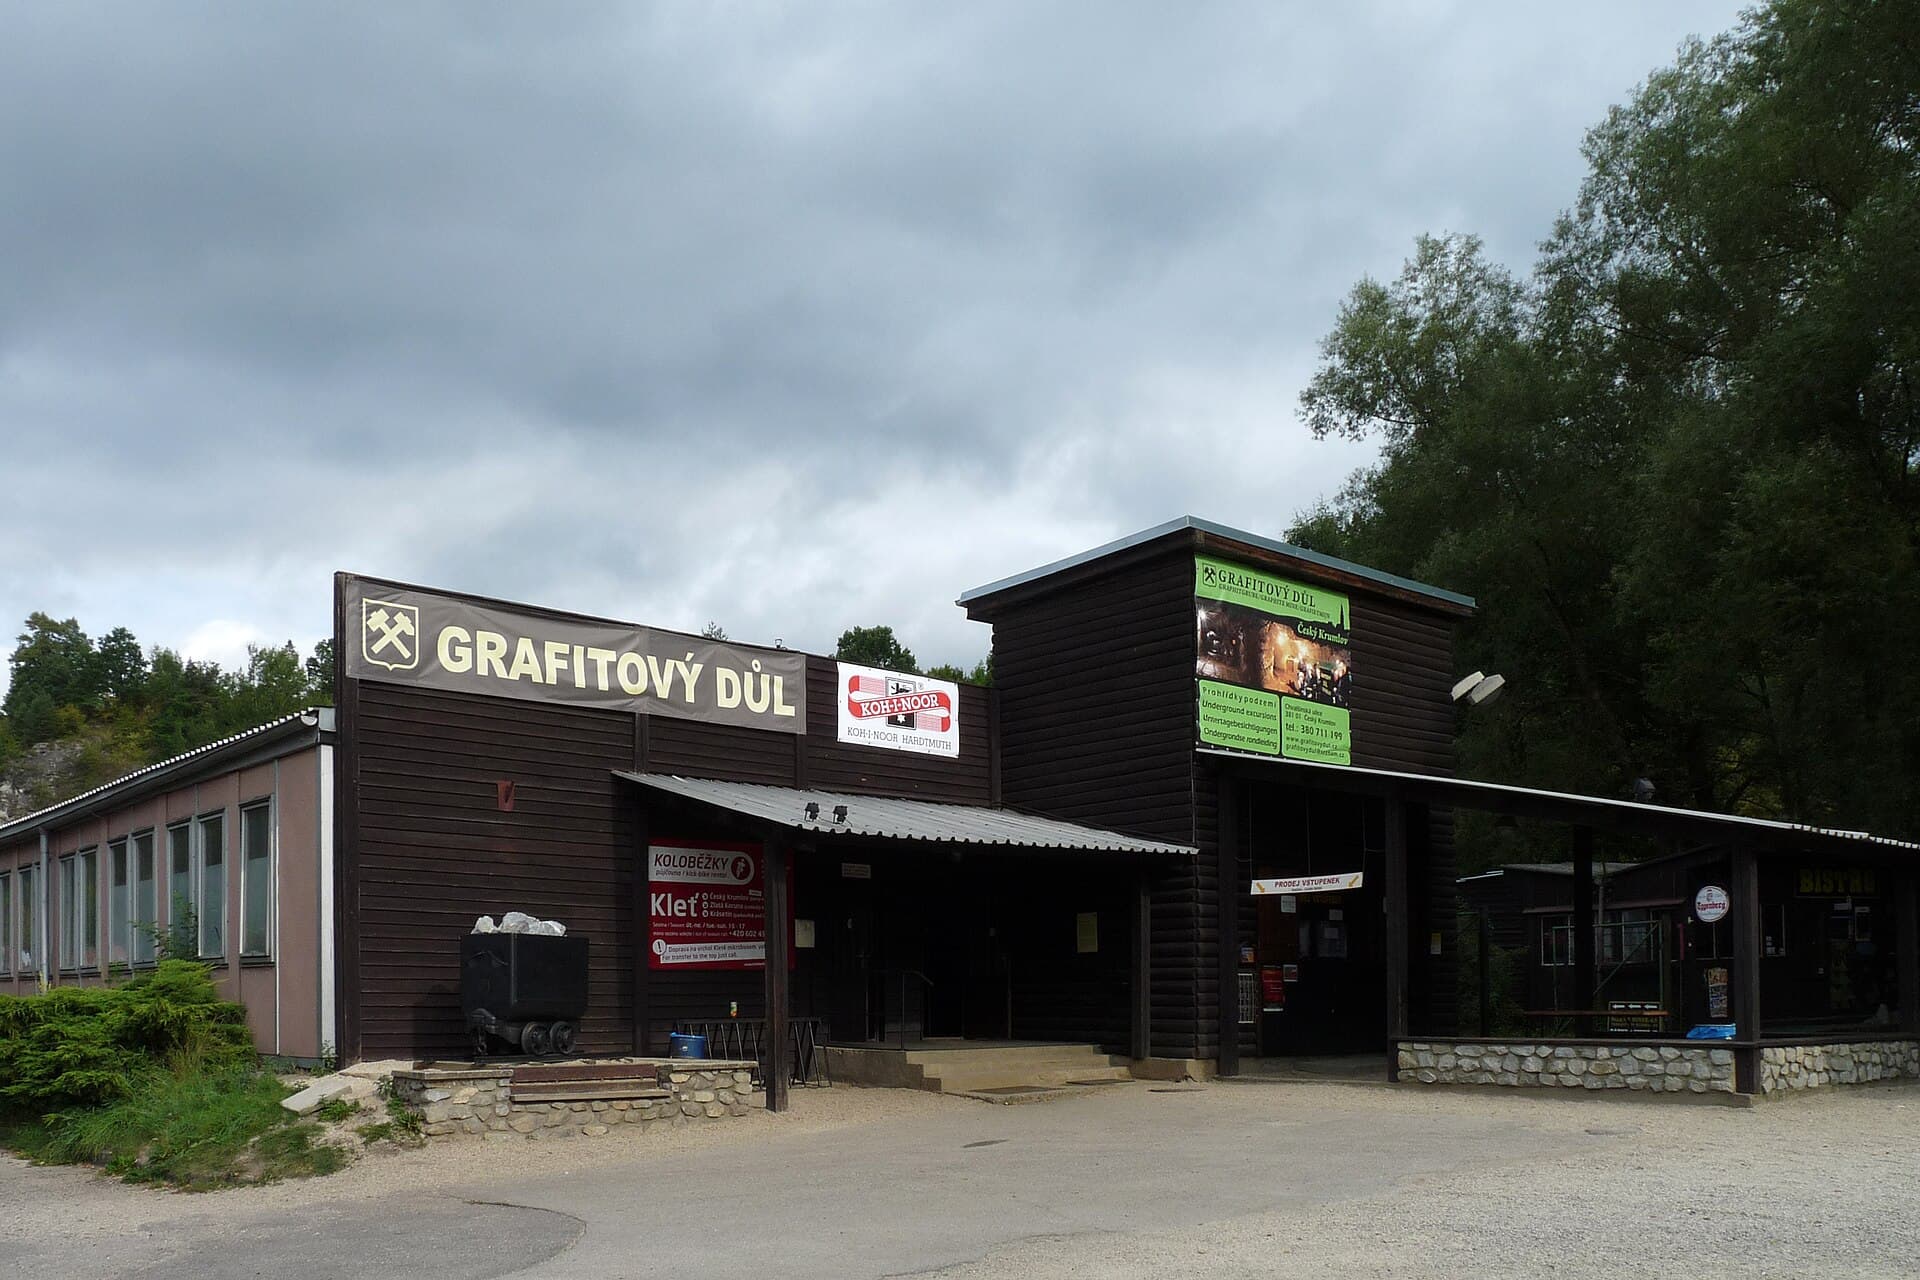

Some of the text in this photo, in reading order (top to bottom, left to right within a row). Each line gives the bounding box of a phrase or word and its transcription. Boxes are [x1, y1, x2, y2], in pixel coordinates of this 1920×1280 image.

[1219, 570, 1316, 607] GRAFITOVÝ DŮL
[1297, 621, 1349, 645] Český Krumlov
[437, 625, 795, 716] GRAFITOVÝ DŮL
[1202, 686, 1243, 703] Prohlídky
[860, 694, 939, 717] KOH-I-NOOR
[1202, 700, 1277, 720] Underground excursions
[1301, 724, 1314, 735] 380
[1316, 728, 1328, 738] 711
[1330, 730, 1343, 740] 199
[902, 735, 952, 750] HARDTMUTH
[1247, 736, 1278, 750] rondleiding
[654, 852, 729, 870] KOLOBĚŽKY
[1302, 878, 1340, 886] VSTUPENEK
[1799, 867, 1875, 894] BISTRO
[651, 892, 700, 917] Kleť
[710, 892, 726, 902] Český
